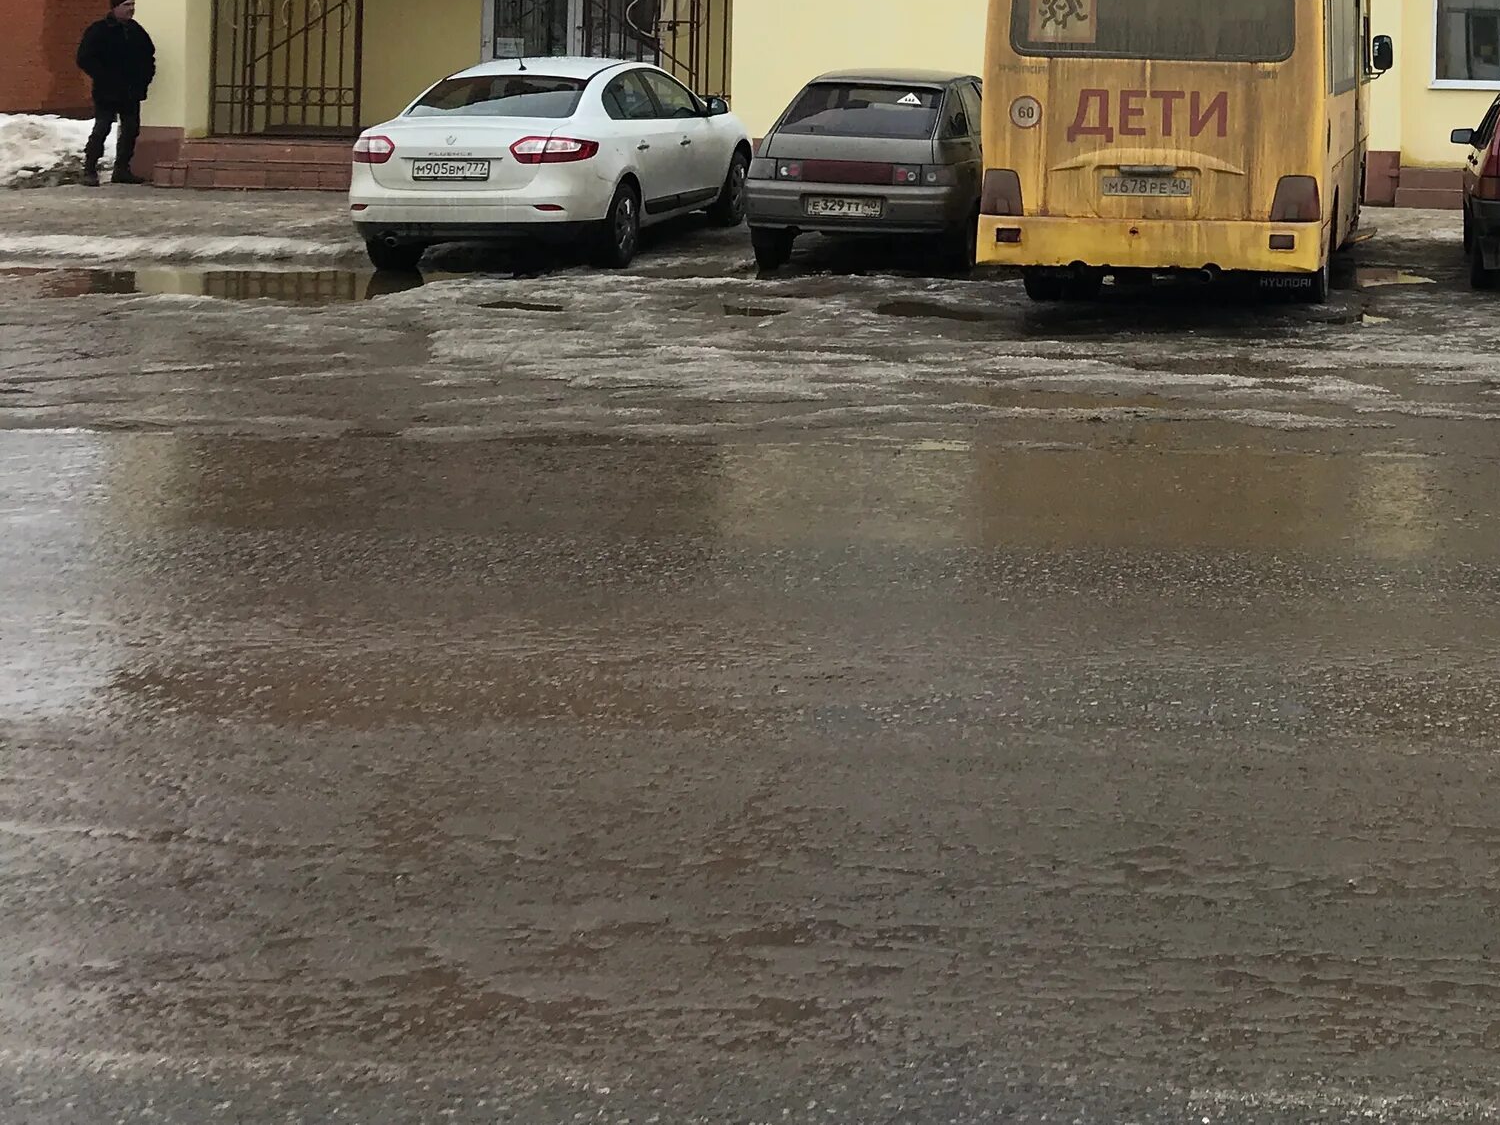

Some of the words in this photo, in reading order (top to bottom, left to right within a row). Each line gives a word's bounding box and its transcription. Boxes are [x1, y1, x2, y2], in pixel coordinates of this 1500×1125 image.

[1018, 106, 1034, 119] 60
[1066, 88, 1229, 143] ДЕТИ
[1260, 277, 1312, 288] HYUNDAI
